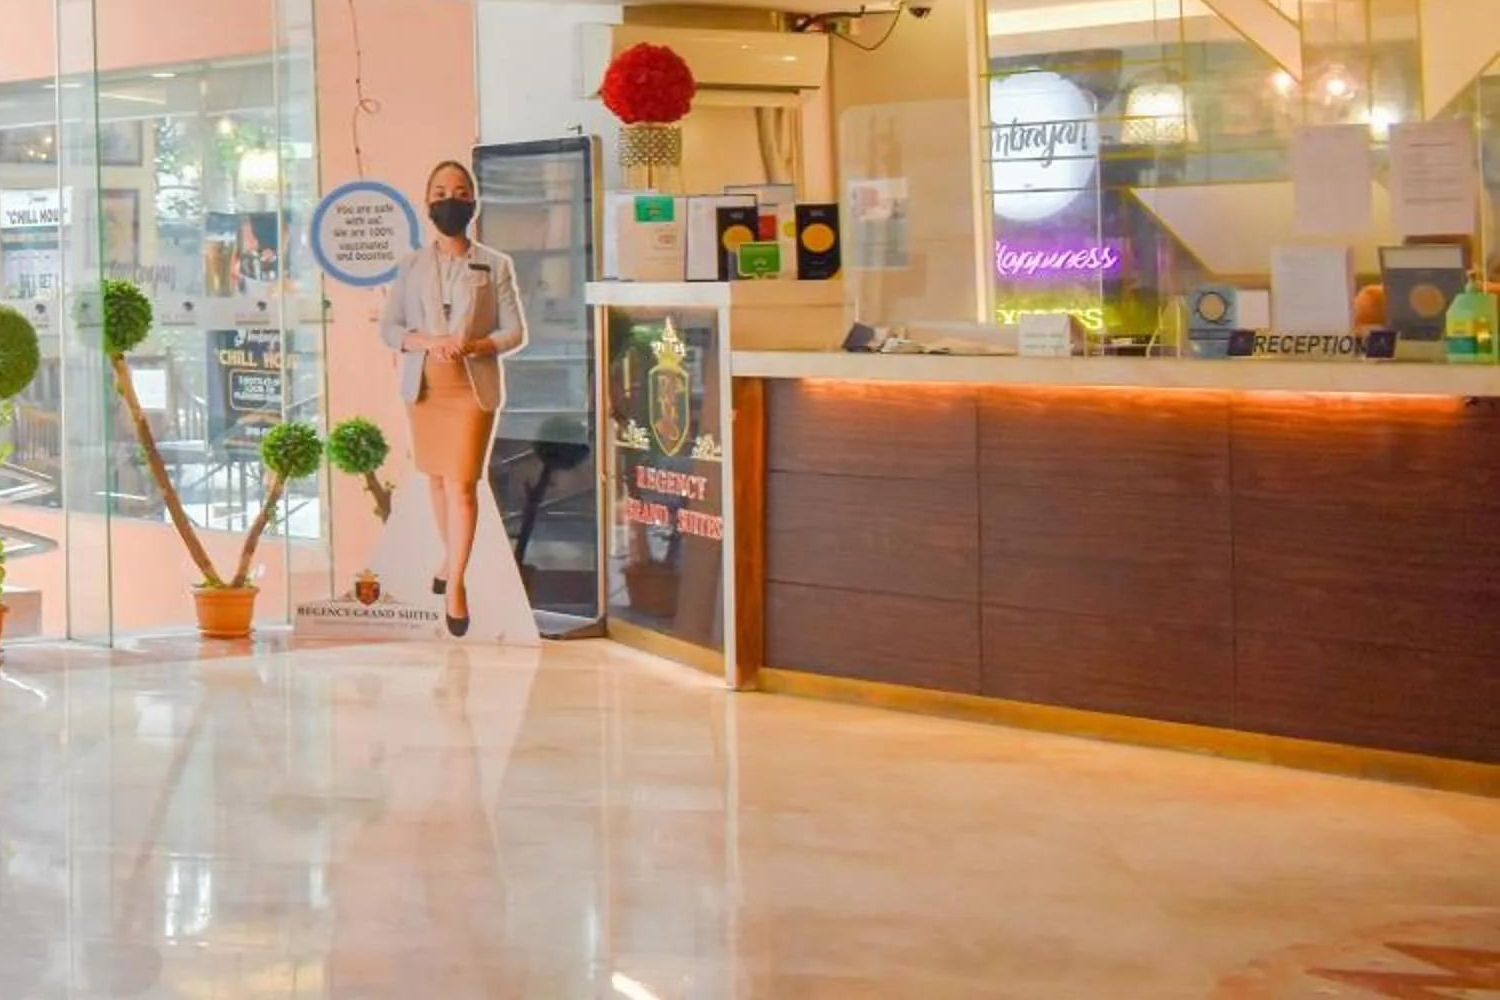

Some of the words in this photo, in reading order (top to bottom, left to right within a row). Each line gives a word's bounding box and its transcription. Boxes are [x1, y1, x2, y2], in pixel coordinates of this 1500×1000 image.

[336, 204, 353, 214] You
[356, 205, 372, 214] are
[350, 229, 365, 237] are
[369, 227, 395, 237] 100%
[636, 465, 708, 500] REGENCY
[627, 497, 670, 526] GRAND
[676, 507, 722, 540] SUITES
[297, 606, 351, 617] REGENCY
[353, 607, 396, 618] GRAND
[399, 609, 439, 621] SUITES
